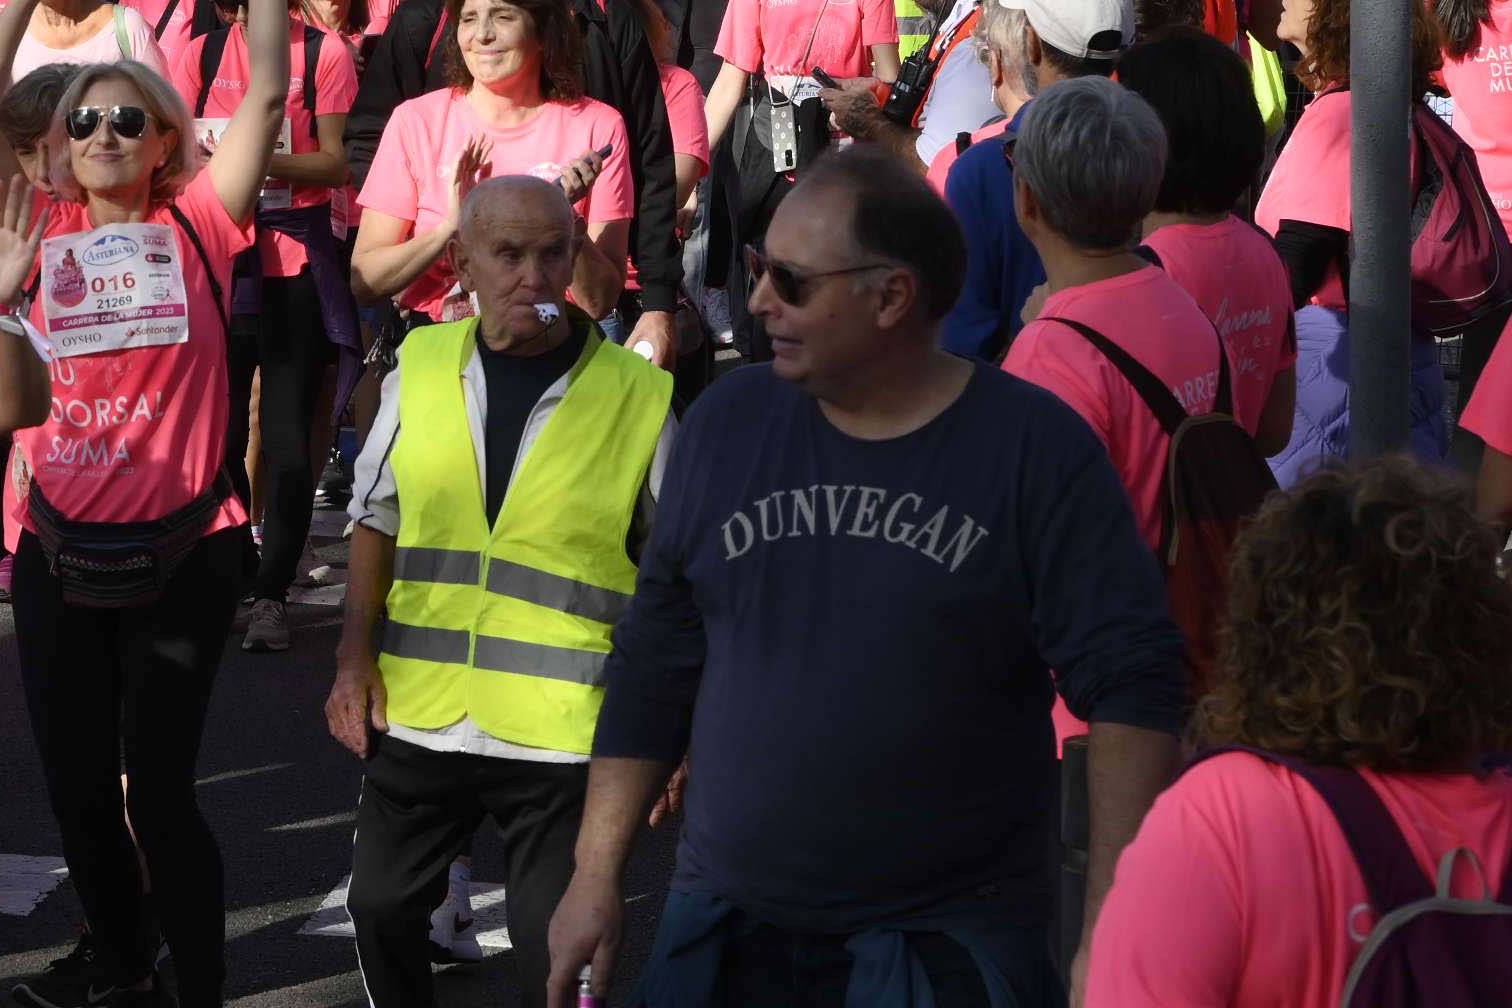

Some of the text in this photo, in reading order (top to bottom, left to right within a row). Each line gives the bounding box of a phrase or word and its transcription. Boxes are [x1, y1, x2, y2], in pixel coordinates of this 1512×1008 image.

[91, 272, 136, 294] 016
[97, 296, 133, 309] 21269
[62, 314, 99, 328] CARRERA
[101, 313, 113, 323] DE
[124, 309, 153, 321] MUJER
[155, 306, 175, 316] 2023
[62, 325, 179, 348] OYSHO Santander
[50, 390, 165, 429] DORSAL
[46, 435, 130, 466] SUMA
[721, 484, 989, 573] DUNVEGAN
